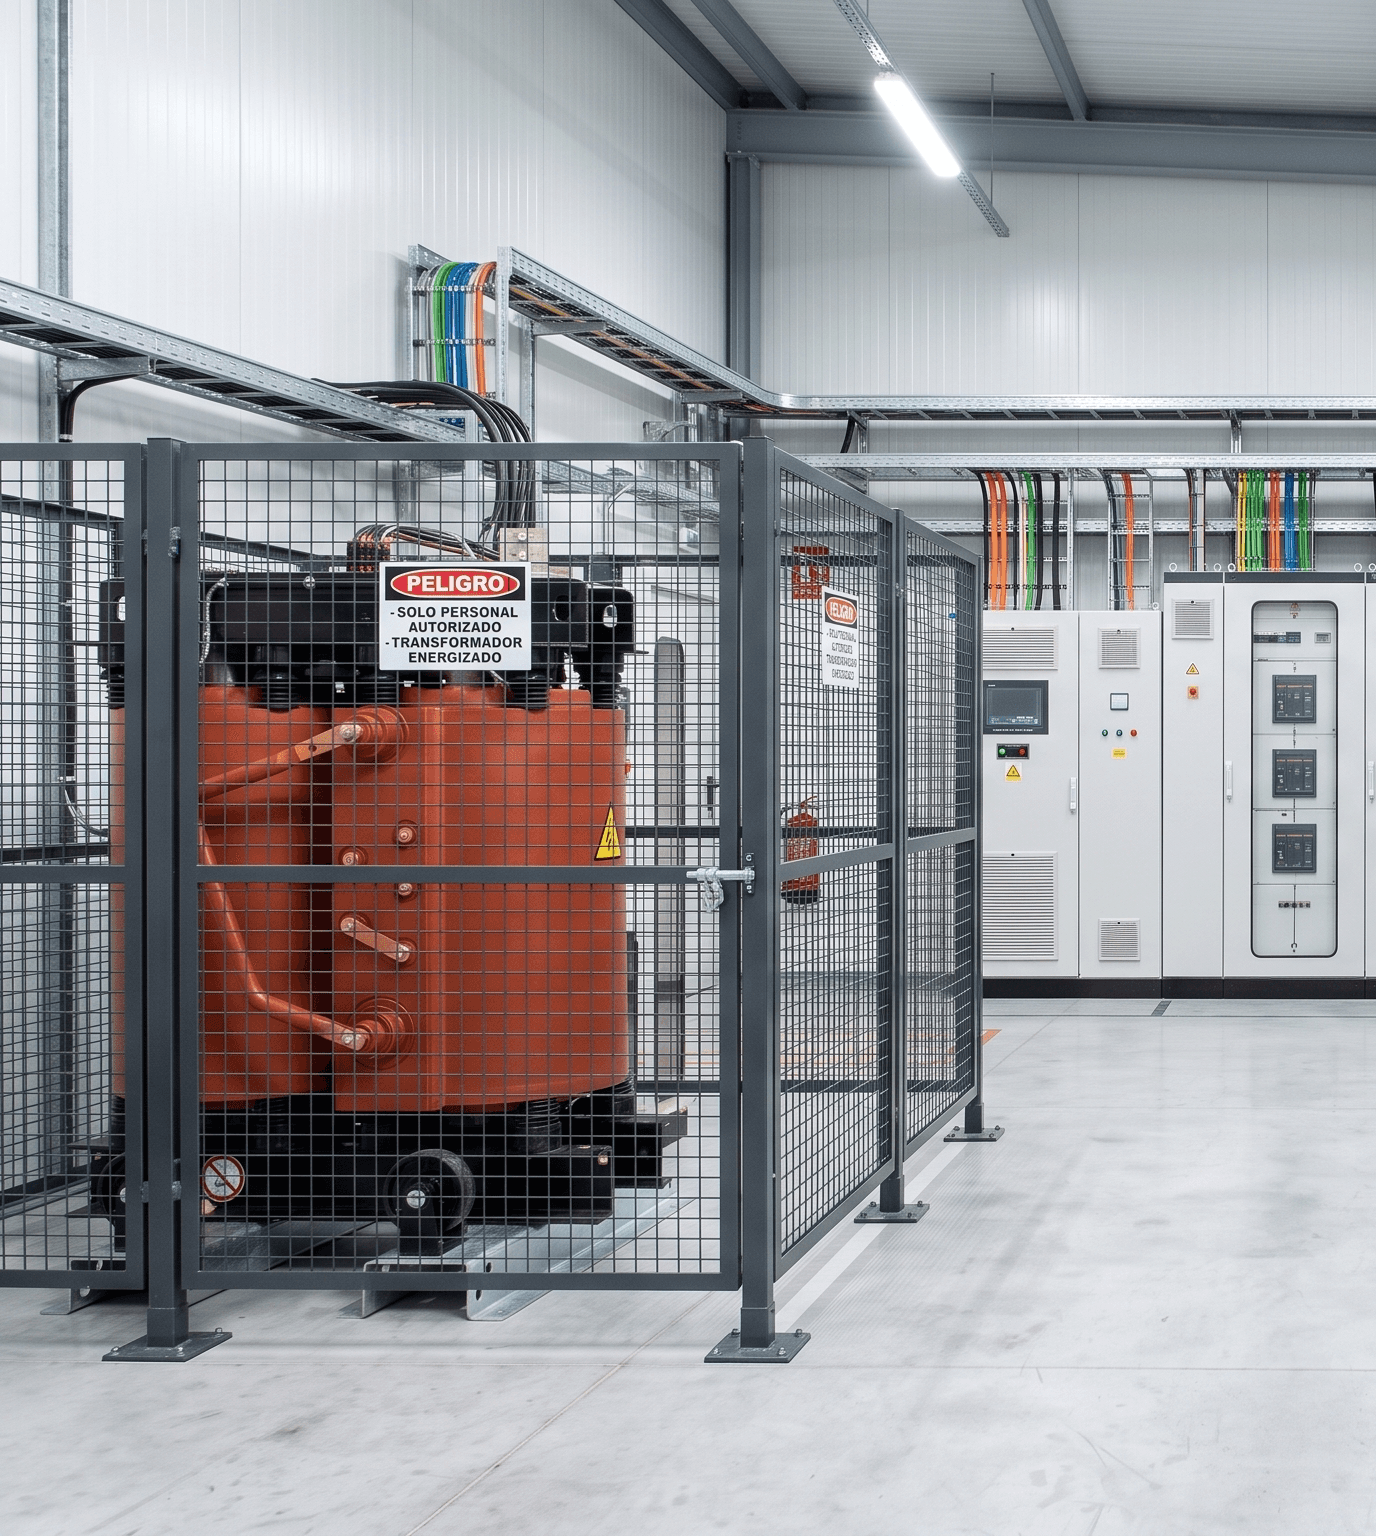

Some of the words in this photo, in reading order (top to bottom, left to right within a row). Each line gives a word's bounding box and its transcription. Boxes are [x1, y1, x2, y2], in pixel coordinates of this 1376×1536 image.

[407, 575, 505, 592] PELIGRO
[441, 606, 519, 618] PERSONAL
[408, 621, 502, 633] AUTORIZADO
[408, 652, 502, 663] ENERGIZADO
